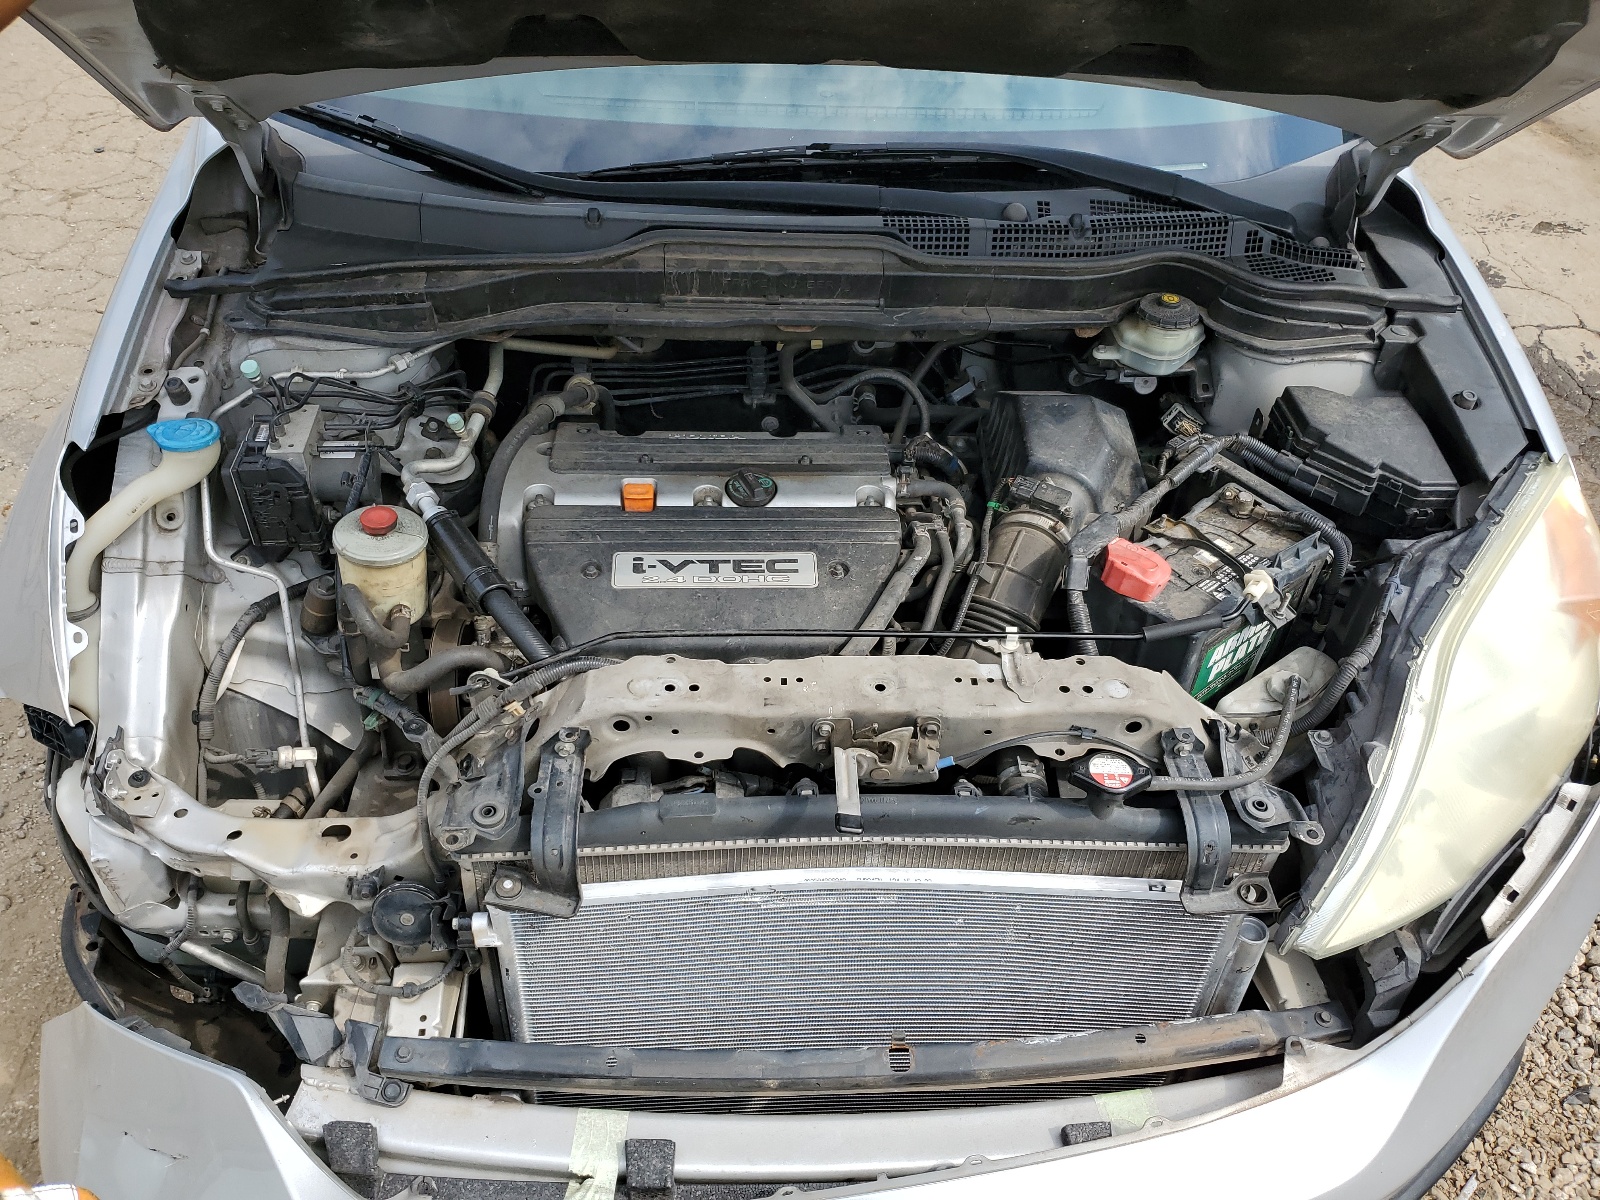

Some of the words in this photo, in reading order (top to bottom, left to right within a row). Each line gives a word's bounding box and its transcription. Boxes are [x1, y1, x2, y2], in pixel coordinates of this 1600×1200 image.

[632, 556, 799, 575] i-VTEC
[642, 575, 687, 584] 2.4
[692, 575, 791, 584] DOHC
